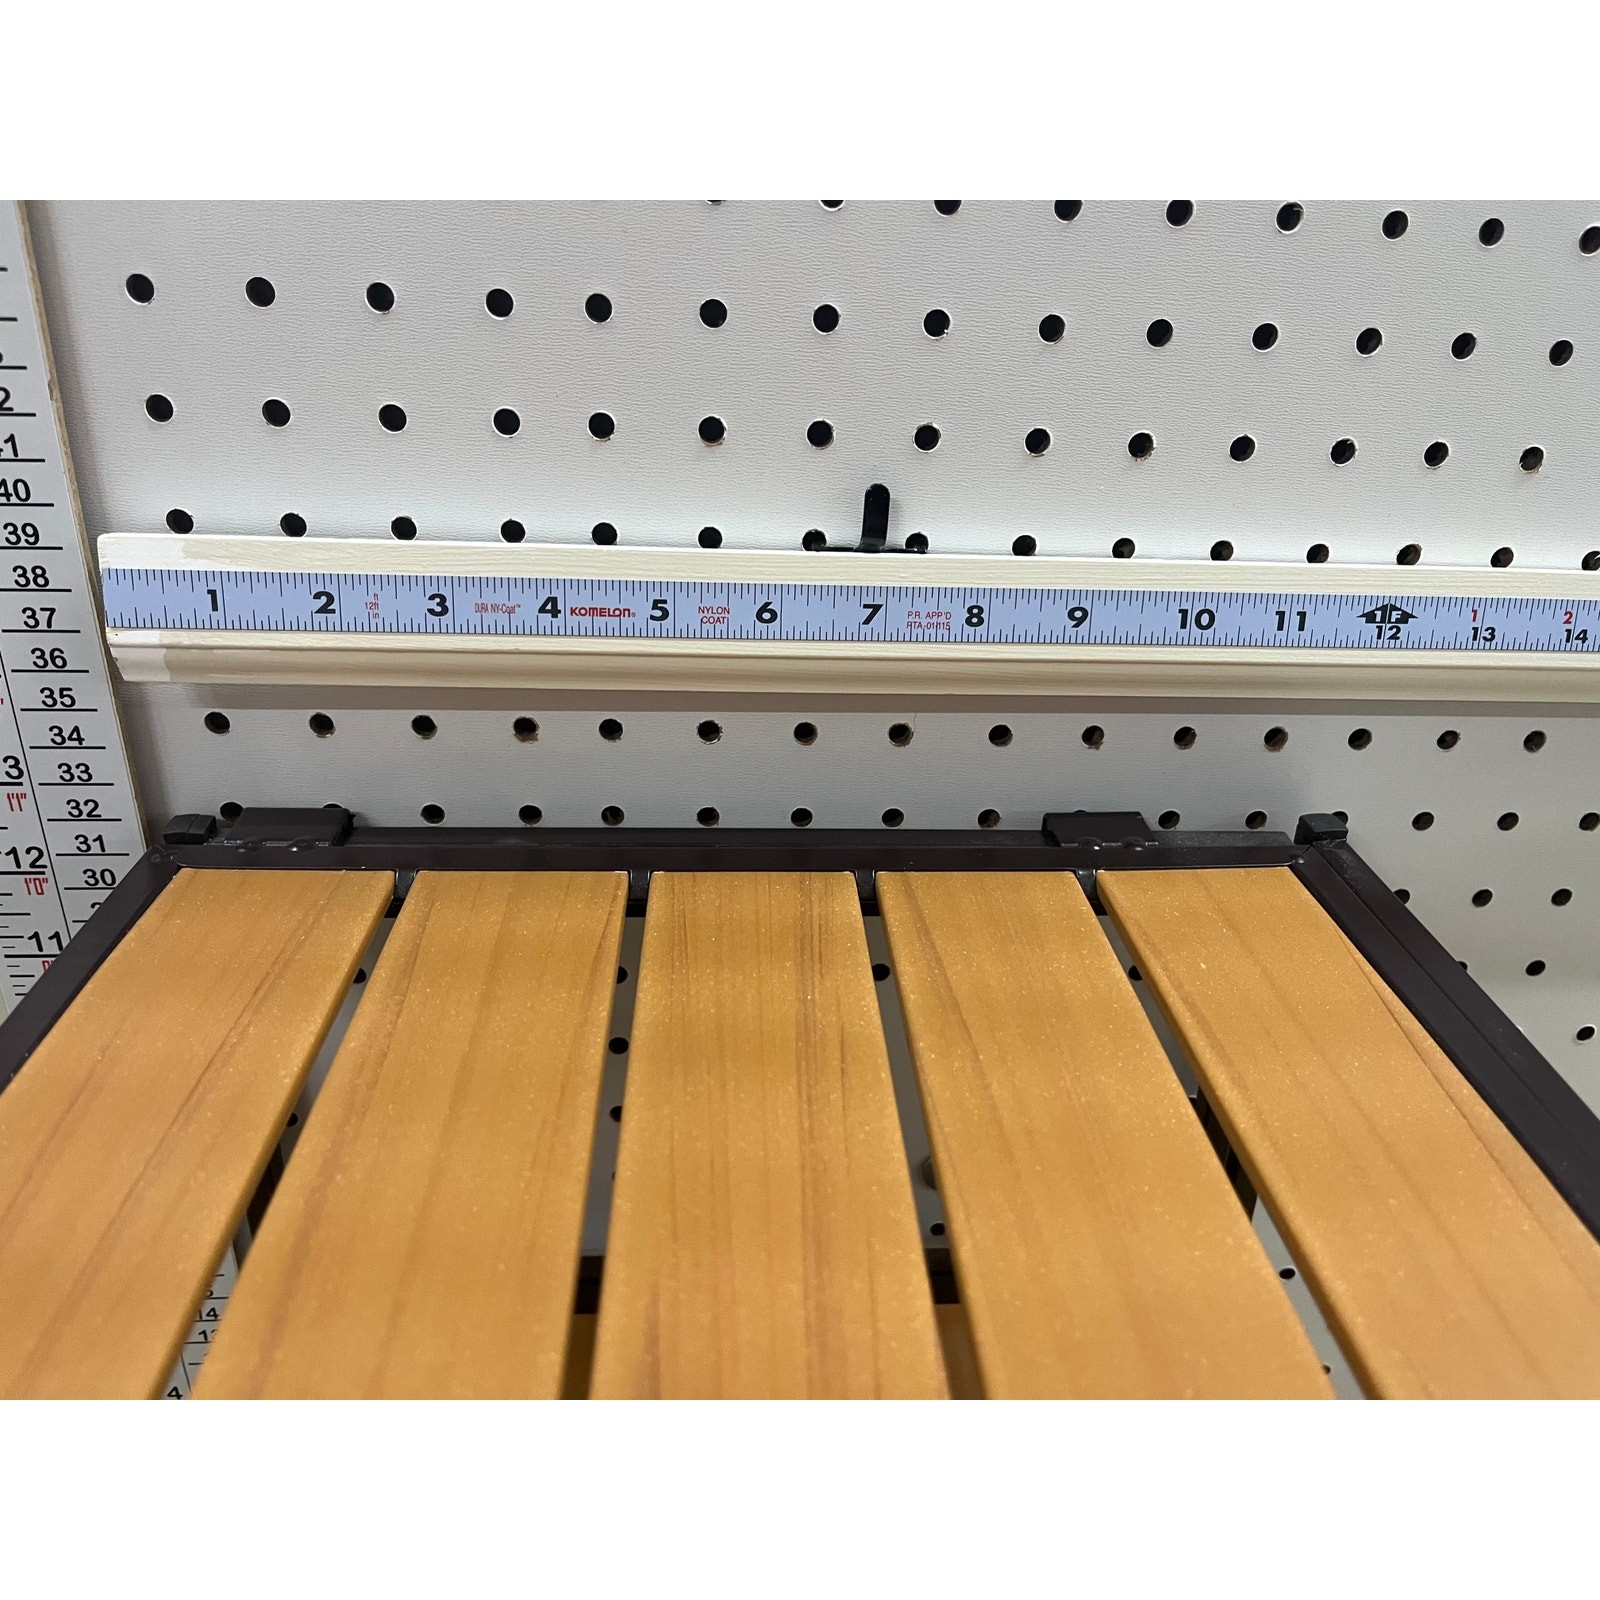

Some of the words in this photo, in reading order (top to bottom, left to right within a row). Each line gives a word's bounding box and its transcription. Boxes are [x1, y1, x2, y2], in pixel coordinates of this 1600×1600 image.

[0, 478, 31, 502] 40
[3, 522, 40, 545] 39
[12, 565, 49, 588] 38
[206, 588, 219, 612] 1
[312, 590, 336, 614] 2
[426, 593, 449, 617] 3
[538, 596, 562, 619] 4
[649, 599, 670, 622] 5
[698, 606, 730, 615] NYLON
[21, 607, 56, 629] 37
[701, 616, 726, 625] COAT
[755, 601, 778, 624] 6
[861, 603, 883, 626] 7
[965, 605, 985, 628] 8
[1067, 605, 1089, 629] 9
[1178, 608, 1216, 631] 10
[1275, 610, 1307, 632] 11
[1471, 609, 1478, 622] 1
[1562, 610, 1573, 625] 2
[1375, 625, 1401, 640] 12
[1471, 626, 1496, 642] 13
[1565, 628, 1589, 644] 14
[30, 647, 67, 669] 36
[39, 687, 76, 708] 35
[48, 725, 85, 746] 34
[57, 762, 93, 782] 33
[65, 799, 102, 818] 32
[74, 834, 106, 853] 31
[4, 846, 48, 869] 12
[82, 868, 117, 887] 30
[27, 931, 64, 952] 11
[167, 1386, 183, 1400] 4
